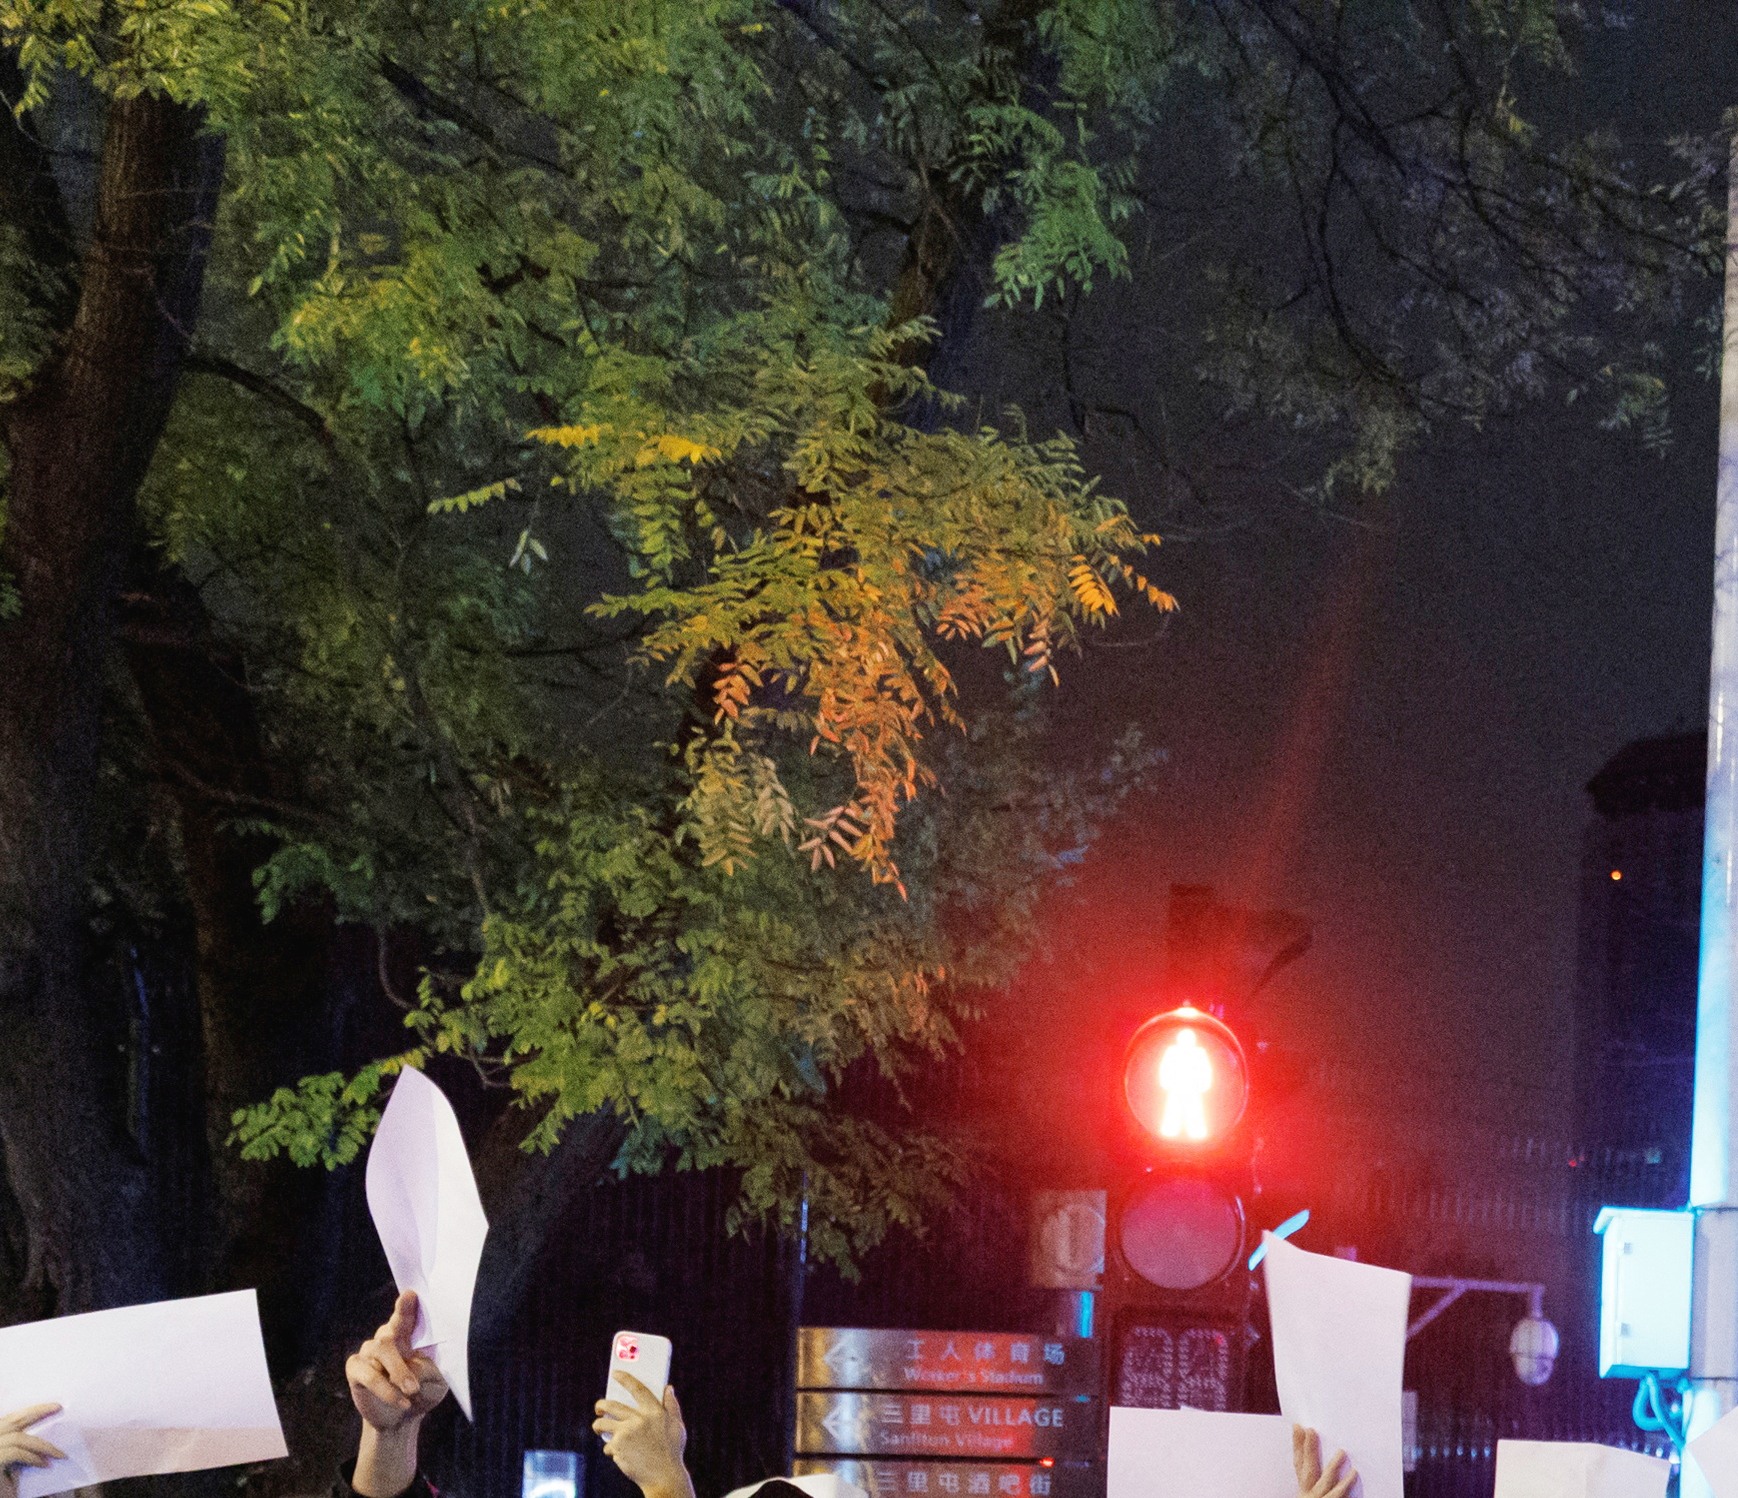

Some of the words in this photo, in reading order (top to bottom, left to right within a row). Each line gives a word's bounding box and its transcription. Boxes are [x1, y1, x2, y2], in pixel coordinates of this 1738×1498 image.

[905, 1339, 1066, 1366] 工人体育场
[979, 1369, 1044, 1385] Stadium
[881, 1403, 961, 1426] 三里屯
[967, 1405, 1065, 1428] VILLAGE
[954, 1432, 1014, 1451] Village
[877, 1470, 1052, 1496] 三里屯酒吧街
